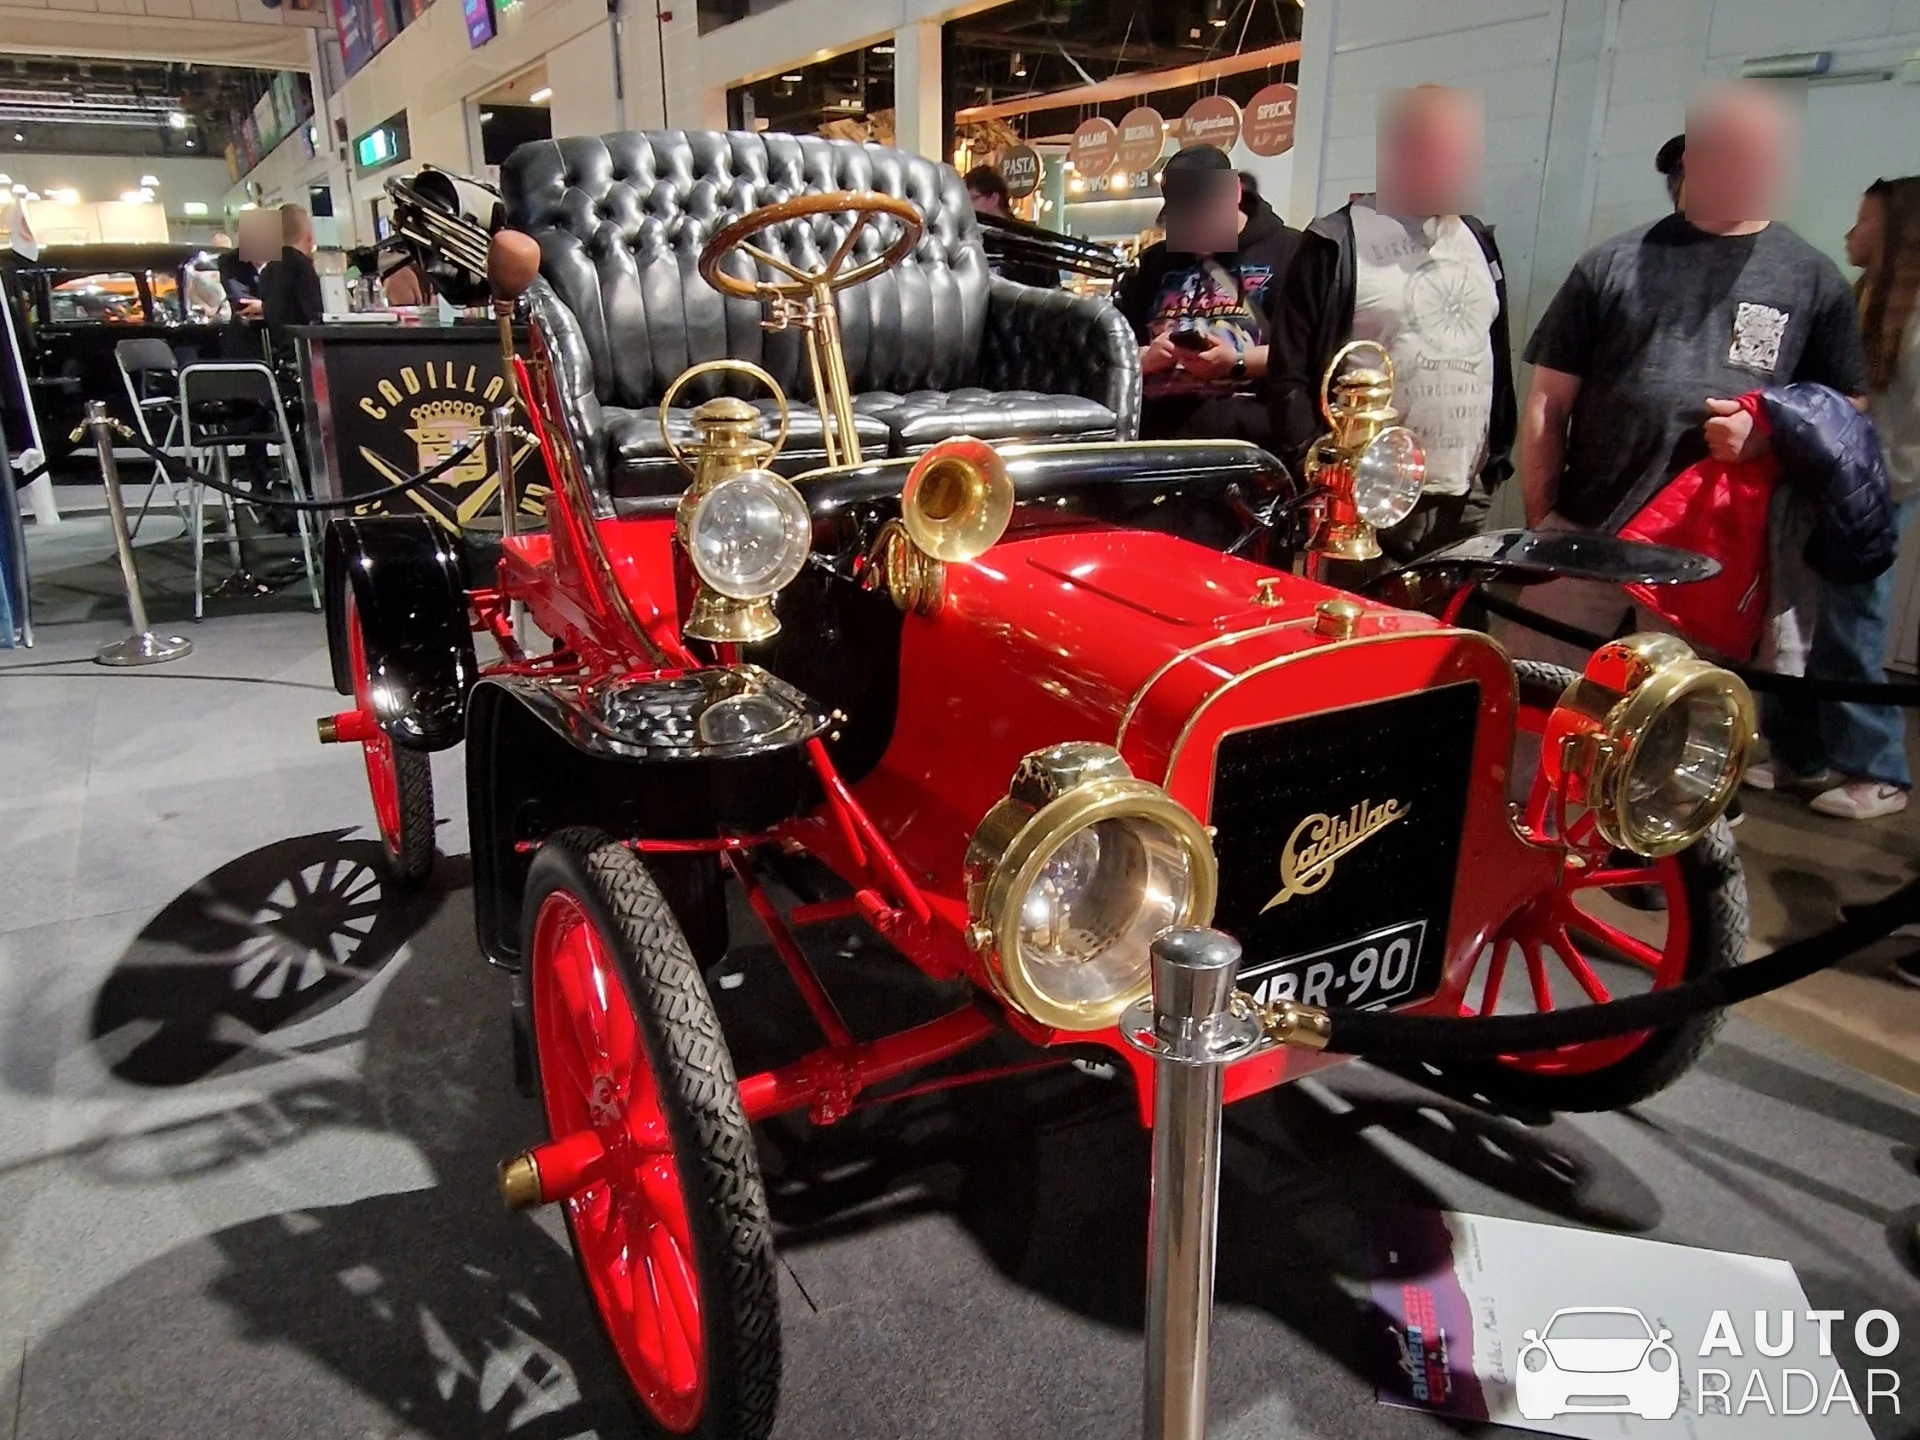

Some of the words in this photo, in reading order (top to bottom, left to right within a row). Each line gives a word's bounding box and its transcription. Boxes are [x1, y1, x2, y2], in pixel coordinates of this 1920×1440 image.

[1257, 100, 1292, 120] SPECK
[1078, 131, 1108, 148] SALAMI
[1002, 156, 1036, 176] PASTA
[1270, 798, 1407, 904] Cadillac
